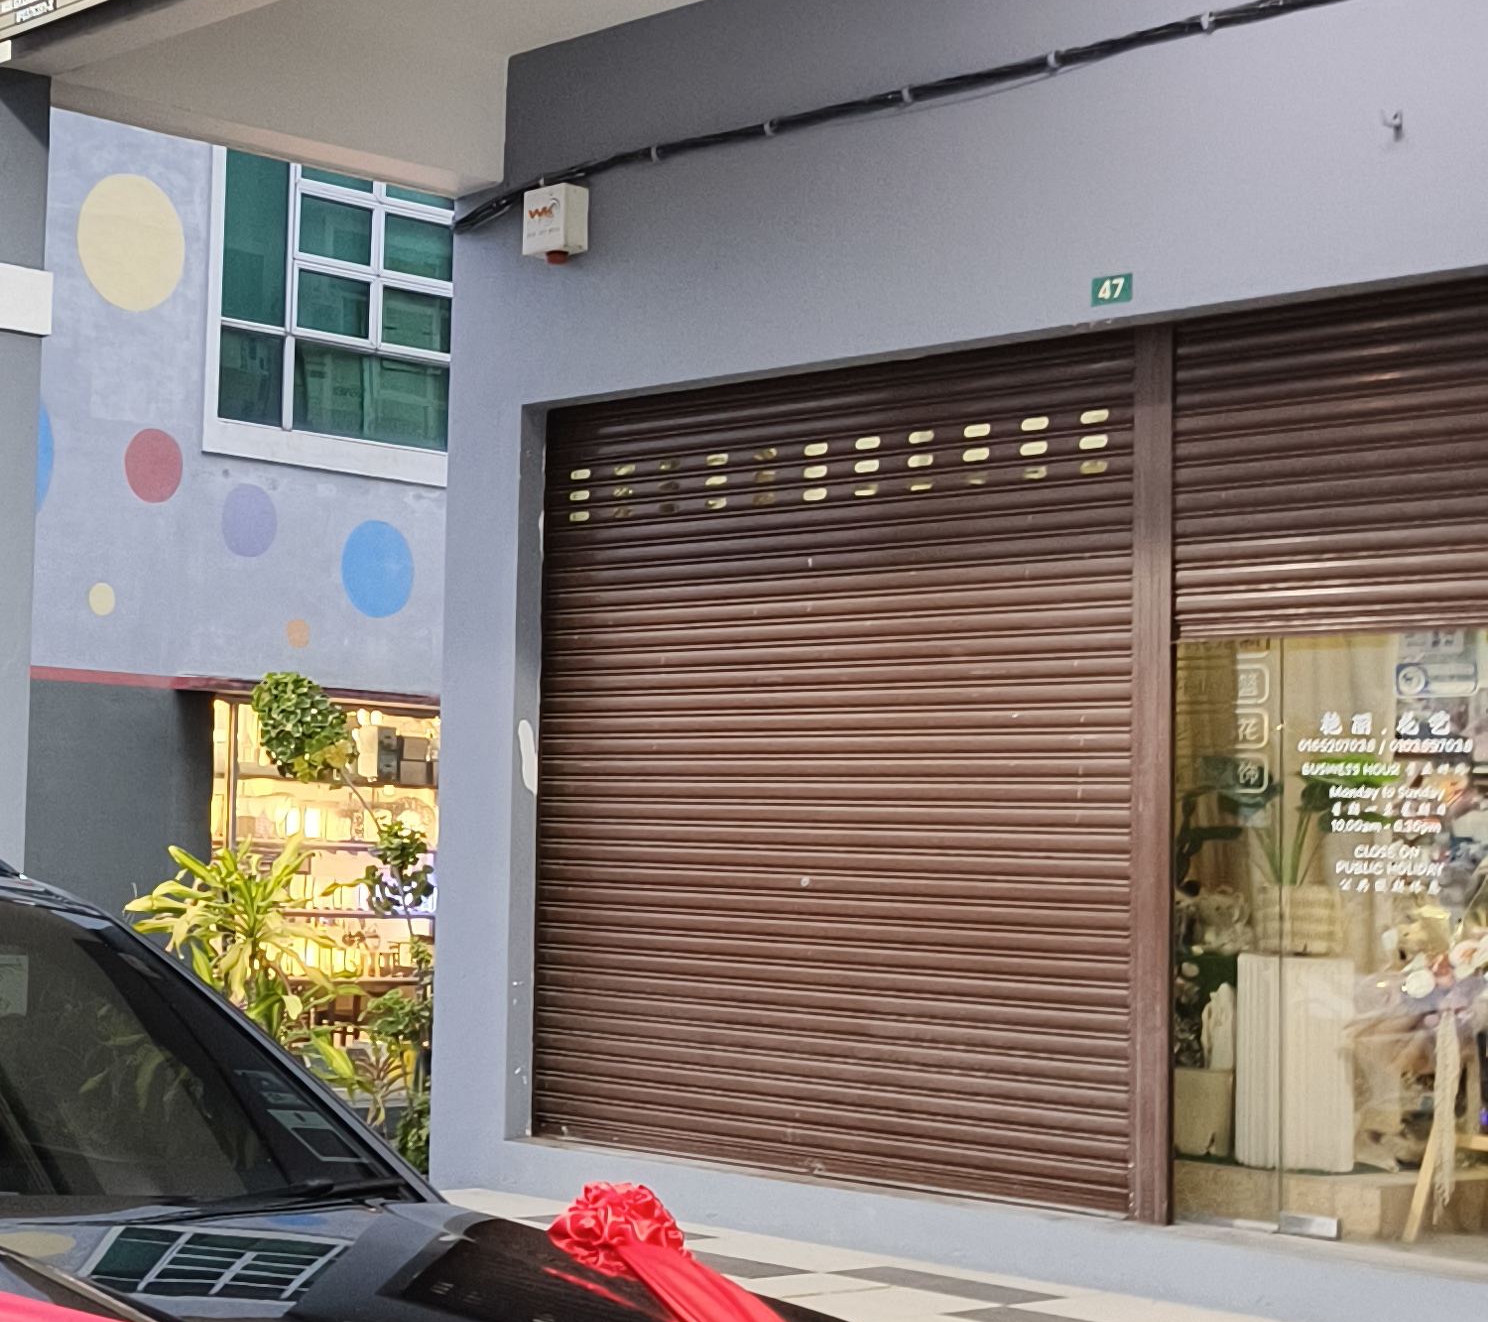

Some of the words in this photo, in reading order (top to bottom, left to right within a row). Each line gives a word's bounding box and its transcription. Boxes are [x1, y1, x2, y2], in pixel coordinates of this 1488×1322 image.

[1097, 277, 1125, 300] 47
[1301, 761, 1361, 776] BUSINESS
[1362, 761, 1401, 776] HOUR
[1329, 784, 1378, 801] Monday
[1335, 859, 1385, 875] PUBLIC
[1386, 861, 1445, 876] HOLIDAY
